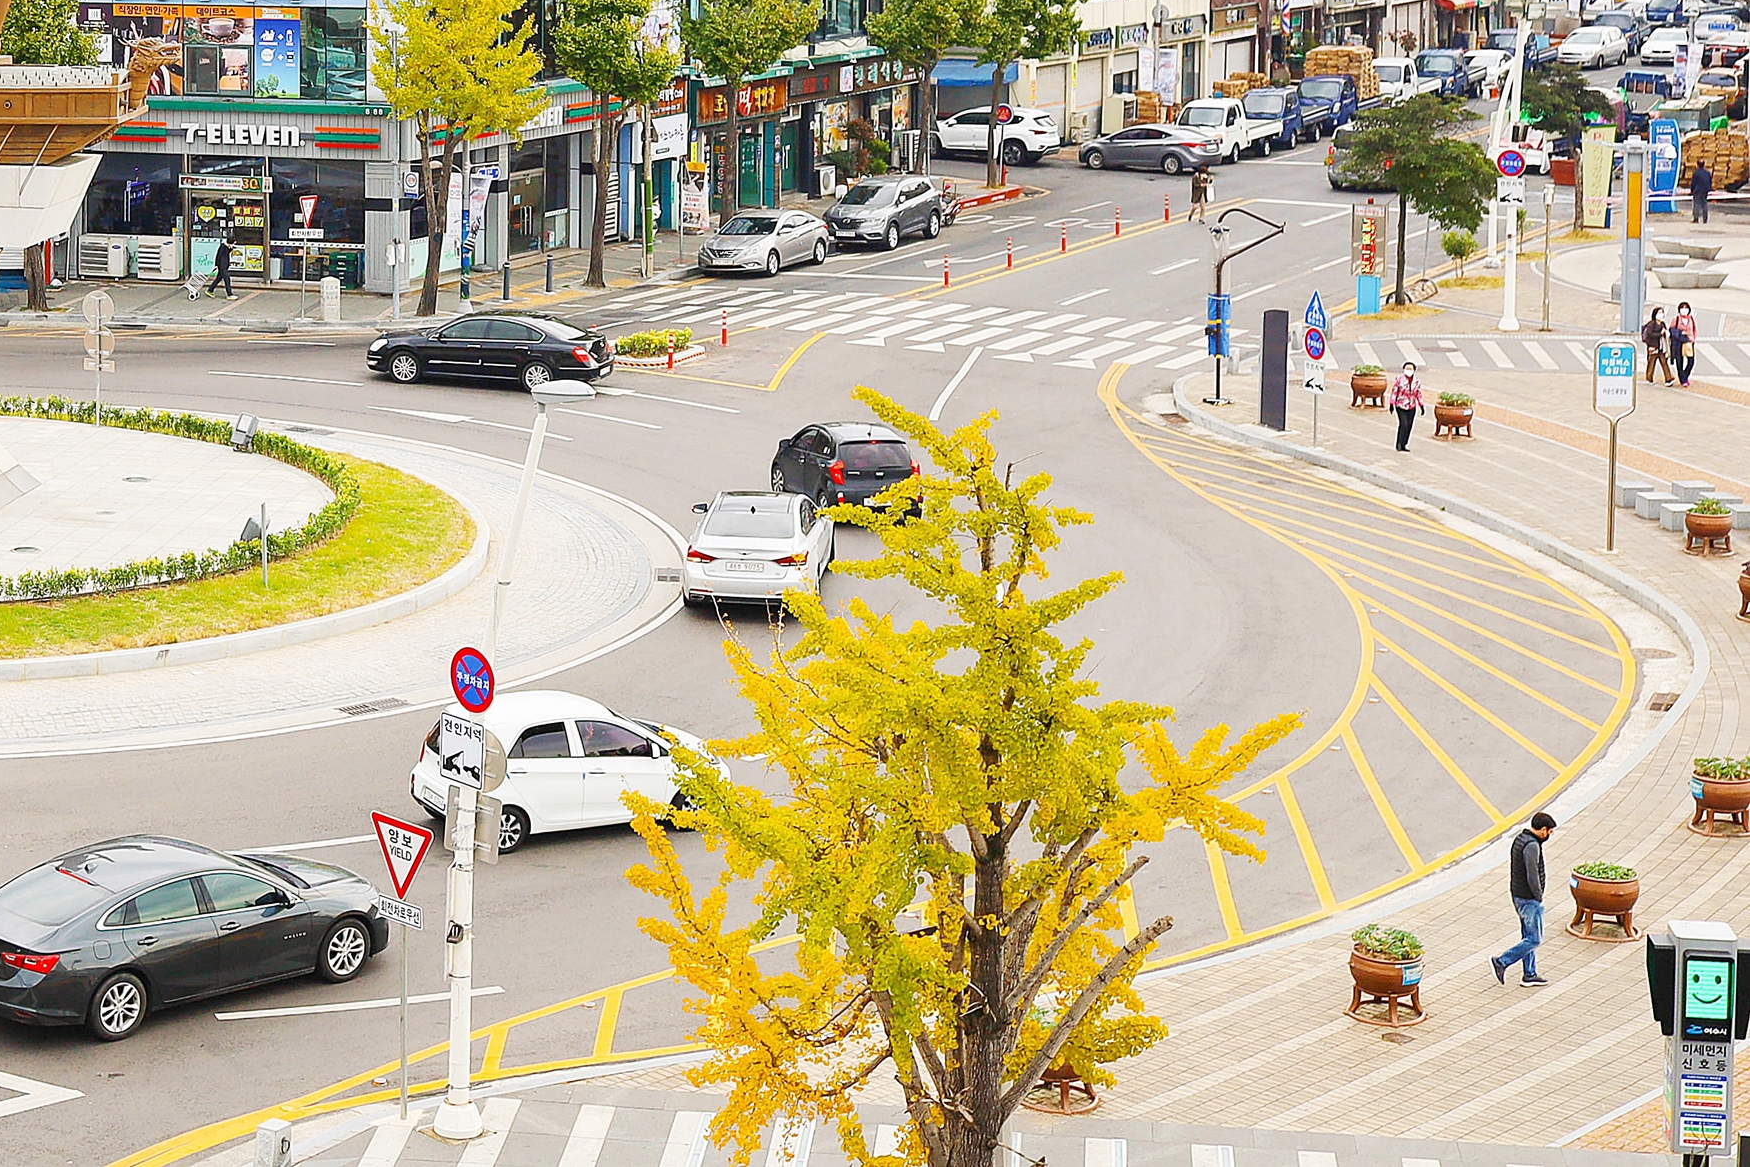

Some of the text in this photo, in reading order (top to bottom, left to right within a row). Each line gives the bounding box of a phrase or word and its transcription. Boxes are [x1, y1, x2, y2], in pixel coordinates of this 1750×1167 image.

[236, 216, 264, 226] DAY
[456, 670, 490, 692] 주정차금지
[444, 718, 482, 743] 견인지역
[388, 828, 413, 849] 양보
[389, 844, 412, 862] YIELD
[1682, 1044, 1727, 1058] 미세먼지
[1682, 1059, 1728, 1072] 신호등
